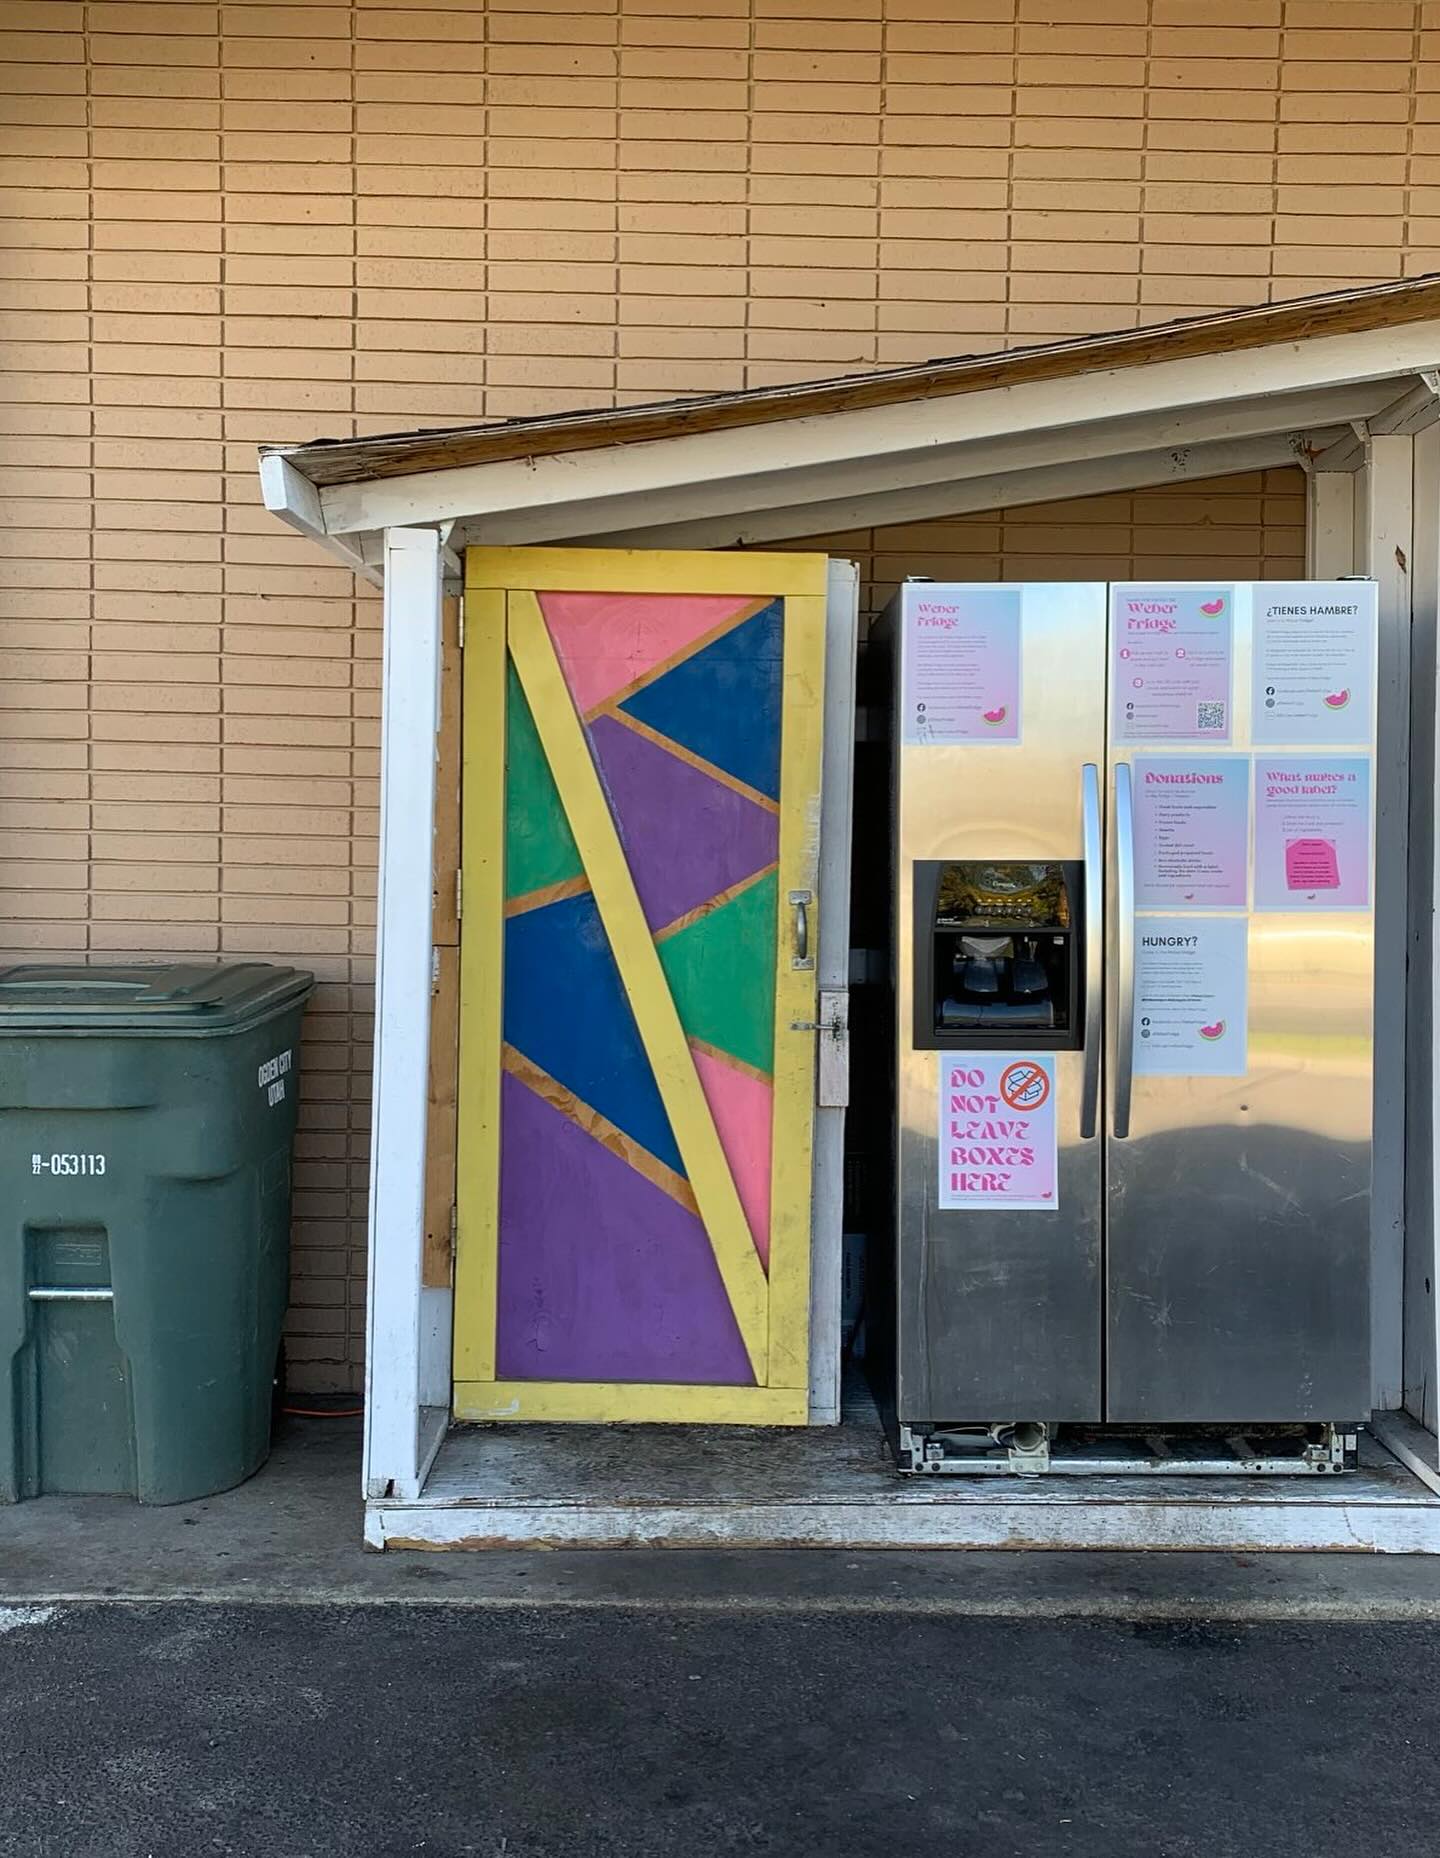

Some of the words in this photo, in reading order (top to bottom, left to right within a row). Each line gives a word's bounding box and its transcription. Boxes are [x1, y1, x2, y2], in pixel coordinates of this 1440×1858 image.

[1127, 602, 1178, 614] Weber
[1266, 606, 1307, 617] ¿TIENES
[1309, 604, 1359, 616] HAMBRE?
[1127, 617, 1177, 633] Fridge
[1145, 771, 1224, 784] Donations
[1266, 771, 1302, 782] What
[1266, 784, 1299, 797] good
[1141, 936, 1198, 947] HUNGRY?
[257, 1056, 279, 1088] OGDEN
[279, 1048, 292, 1076] CITY
[951, 1069, 985, 1088] DO
[267, 1079, 286, 1107] UTAH
[951, 1095, 1001, 1114] NOT
[951, 1120, 1031, 1140] LEAVE
[951, 1147, 1035, 1166] BOXES
[951, 1172, 1011, 1191] HERE
